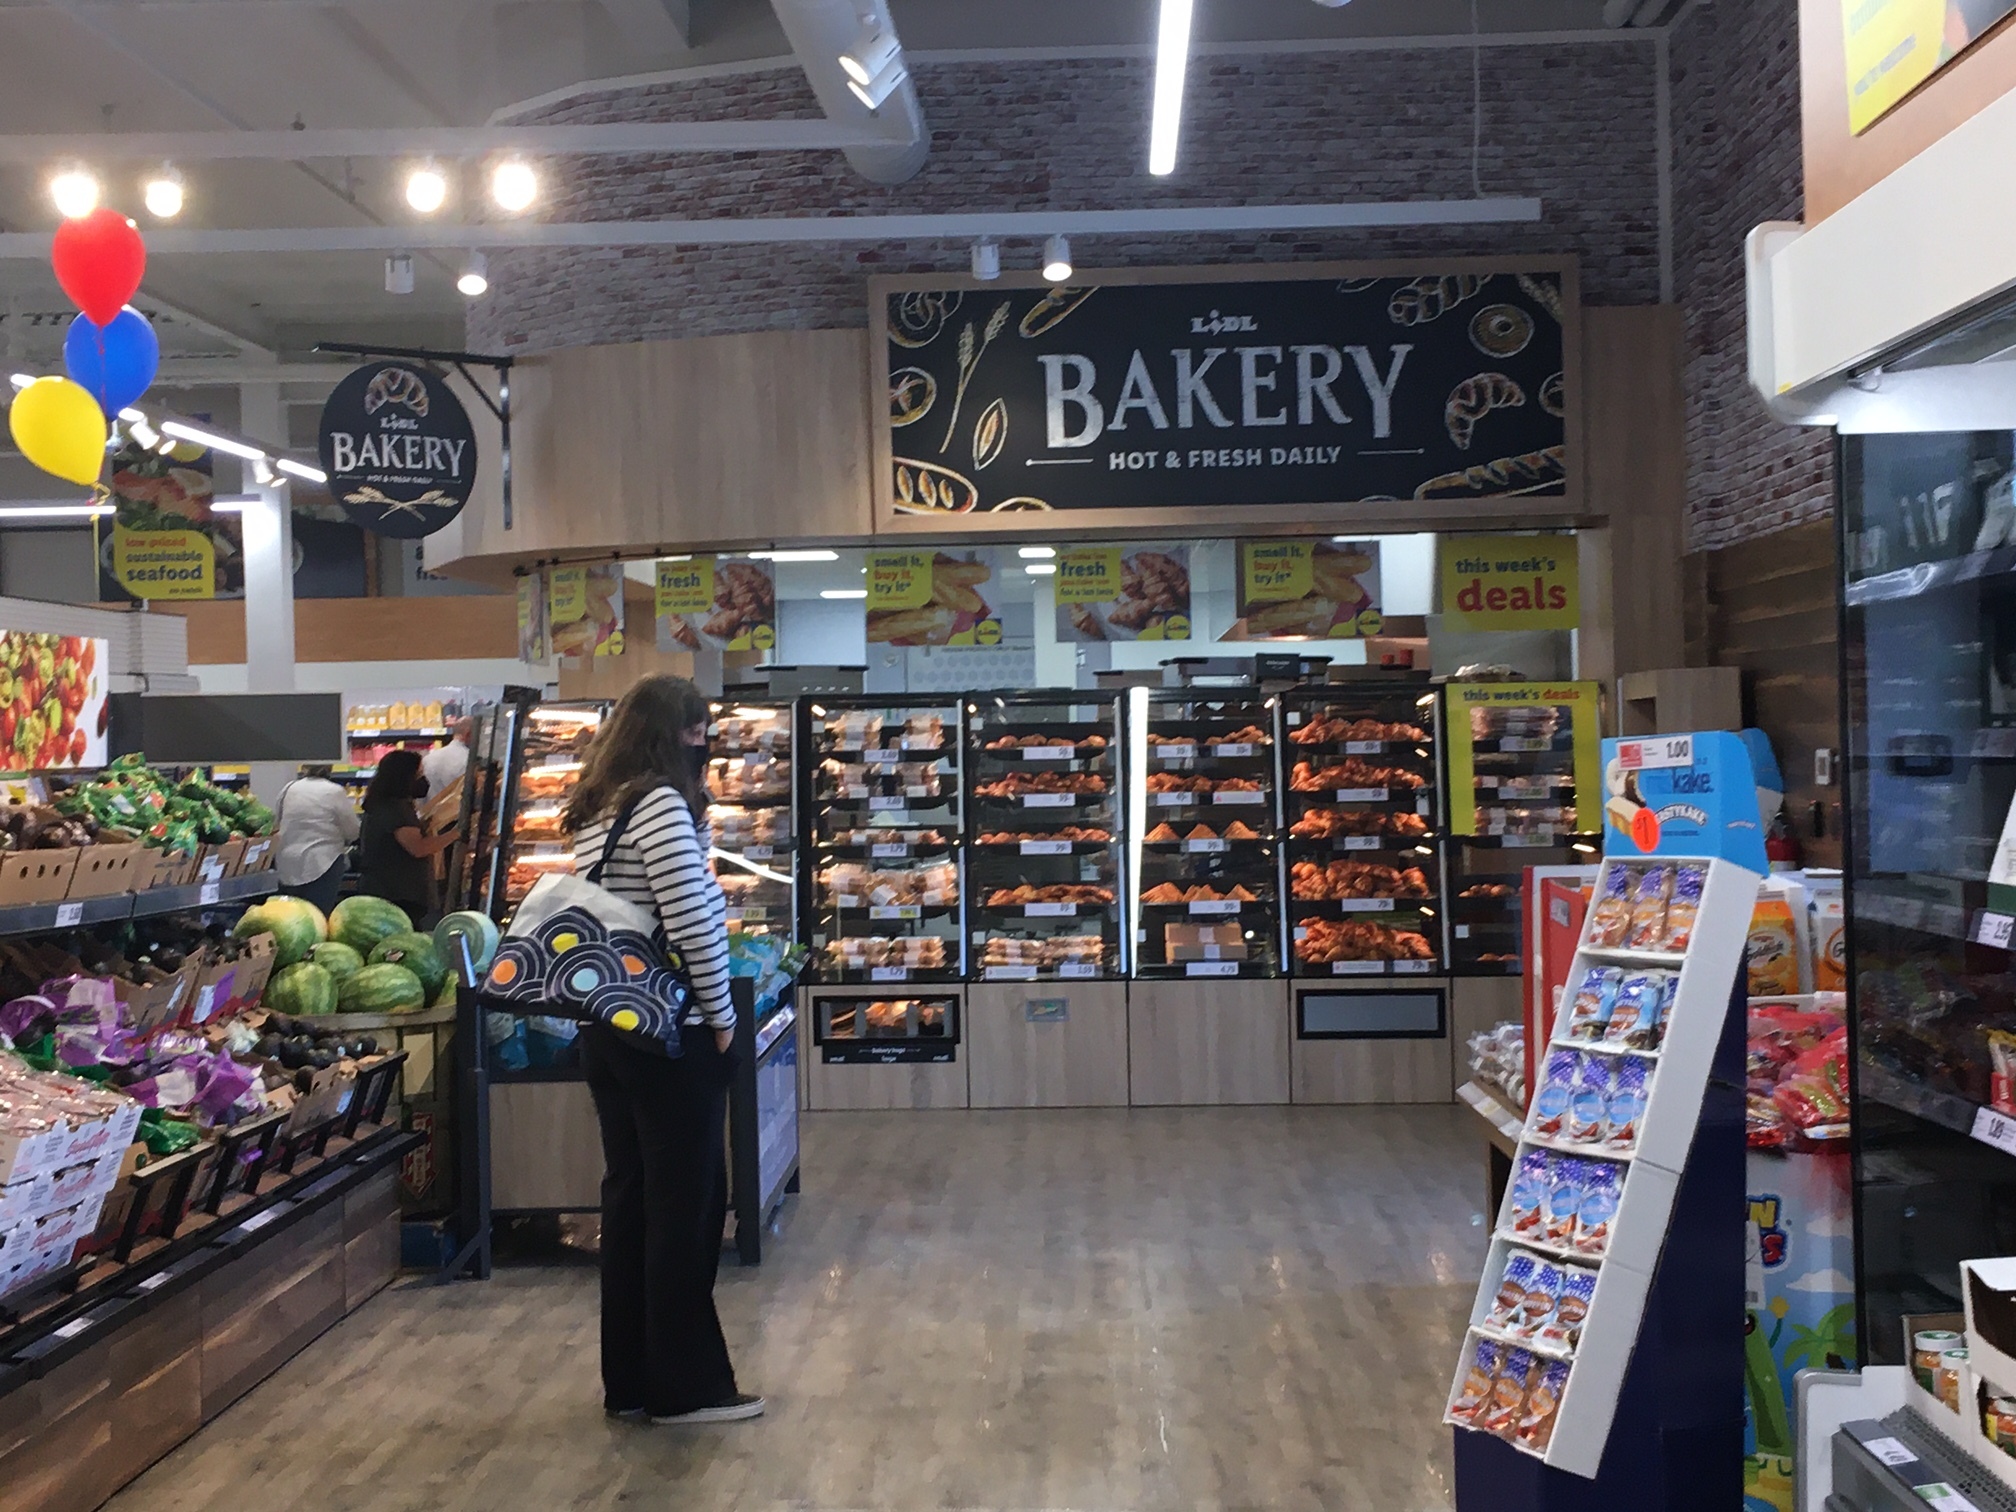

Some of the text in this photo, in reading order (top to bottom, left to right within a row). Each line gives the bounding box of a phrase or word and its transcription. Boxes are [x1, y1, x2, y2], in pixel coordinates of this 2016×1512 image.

[1037, 344, 1414, 449] BAKERY
[330, 431, 468, 478] BAKERY
[1108, 446, 1343, 471] HOT & FRESH DAILY
[126, 549, 204, 563] sustainable
[1253, 547, 1288, 559] smell
[874, 555, 908, 568] smell
[1060, 561, 1106, 577] fresh
[1253, 560, 1278, 573] buy
[1455, 556, 1557, 574] this week's
[126, 564, 204, 582] seafood
[660, 572, 701, 589] fresh
[874, 569, 899, 582] buy
[874, 582, 893, 594] try
[1457, 576, 1568, 612] deals
[1463, 688, 1581, 701] this week's deals
[1666, 740, 1689, 759] 1.00
